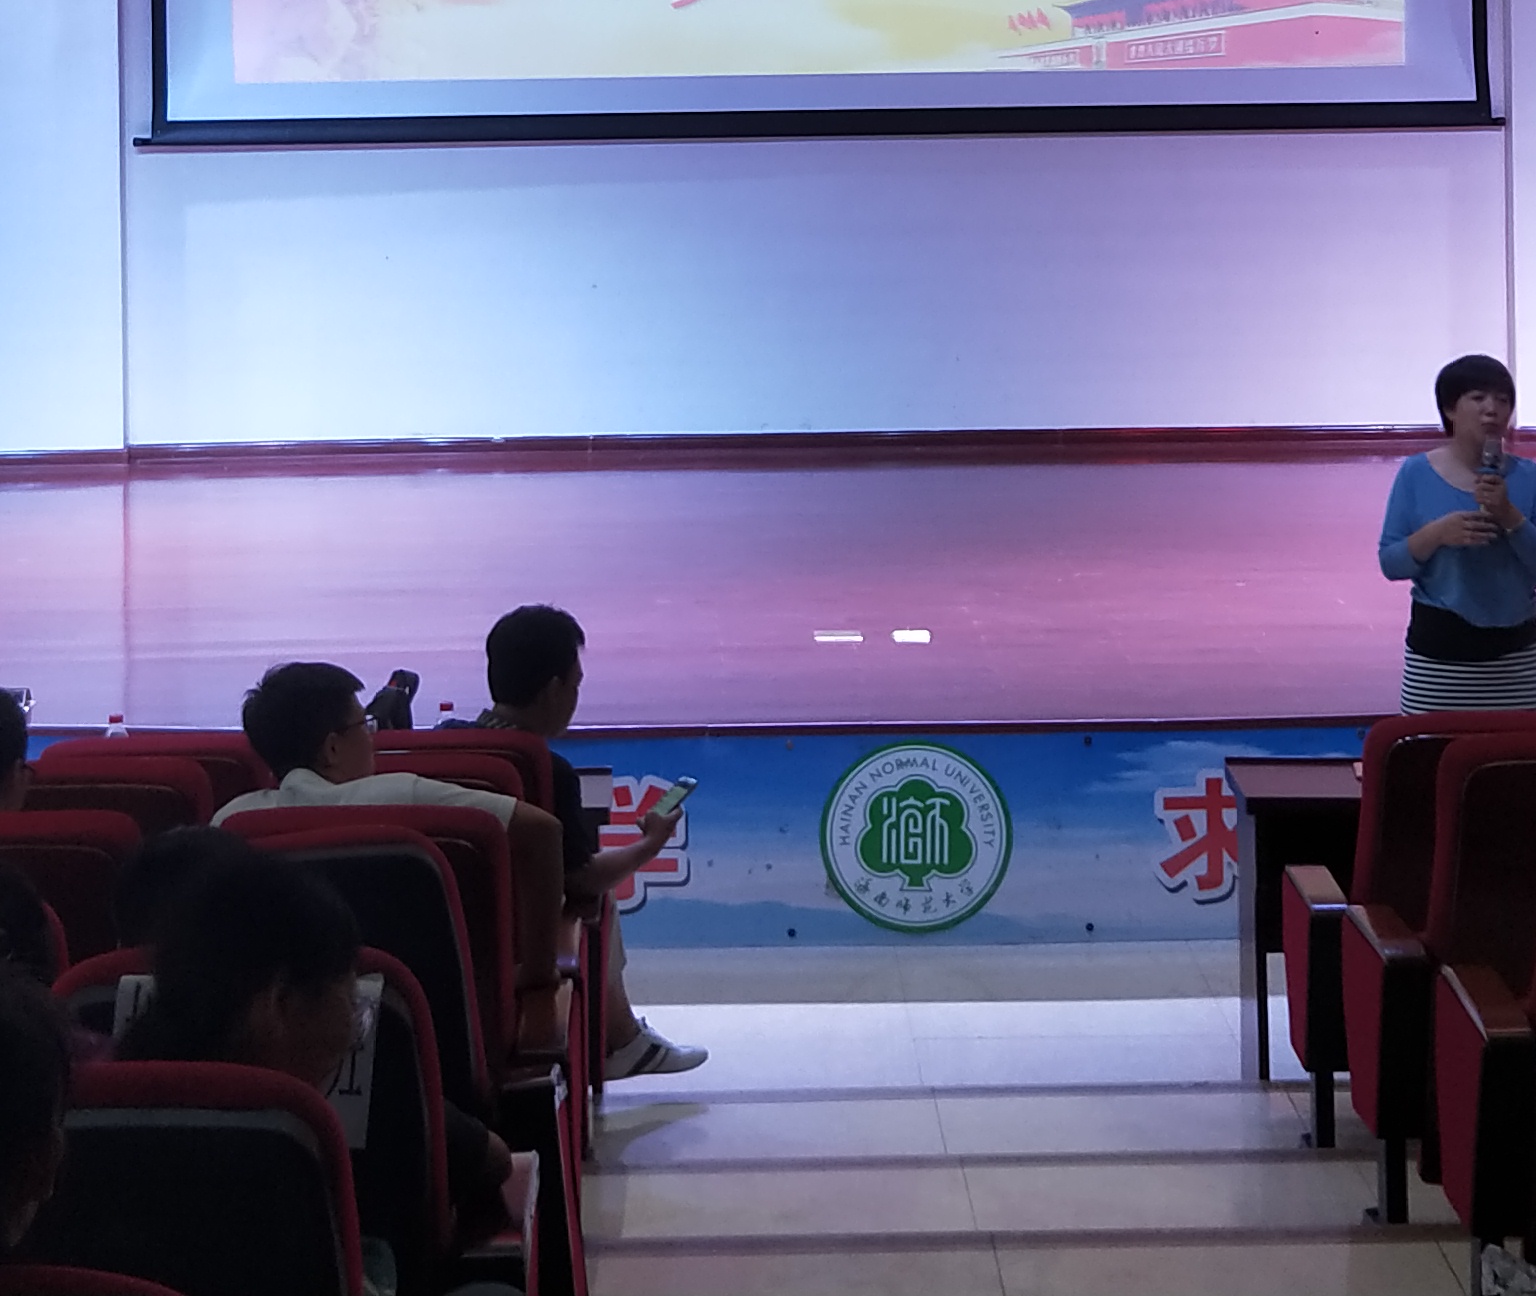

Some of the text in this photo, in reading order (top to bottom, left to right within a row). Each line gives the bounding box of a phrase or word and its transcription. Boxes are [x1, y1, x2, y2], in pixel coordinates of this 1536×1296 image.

[839, 780, 868, 846] HAINAN
[869, 757, 938, 783] NORMAL
[944, 763, 996, 849] UNIVERSITY
